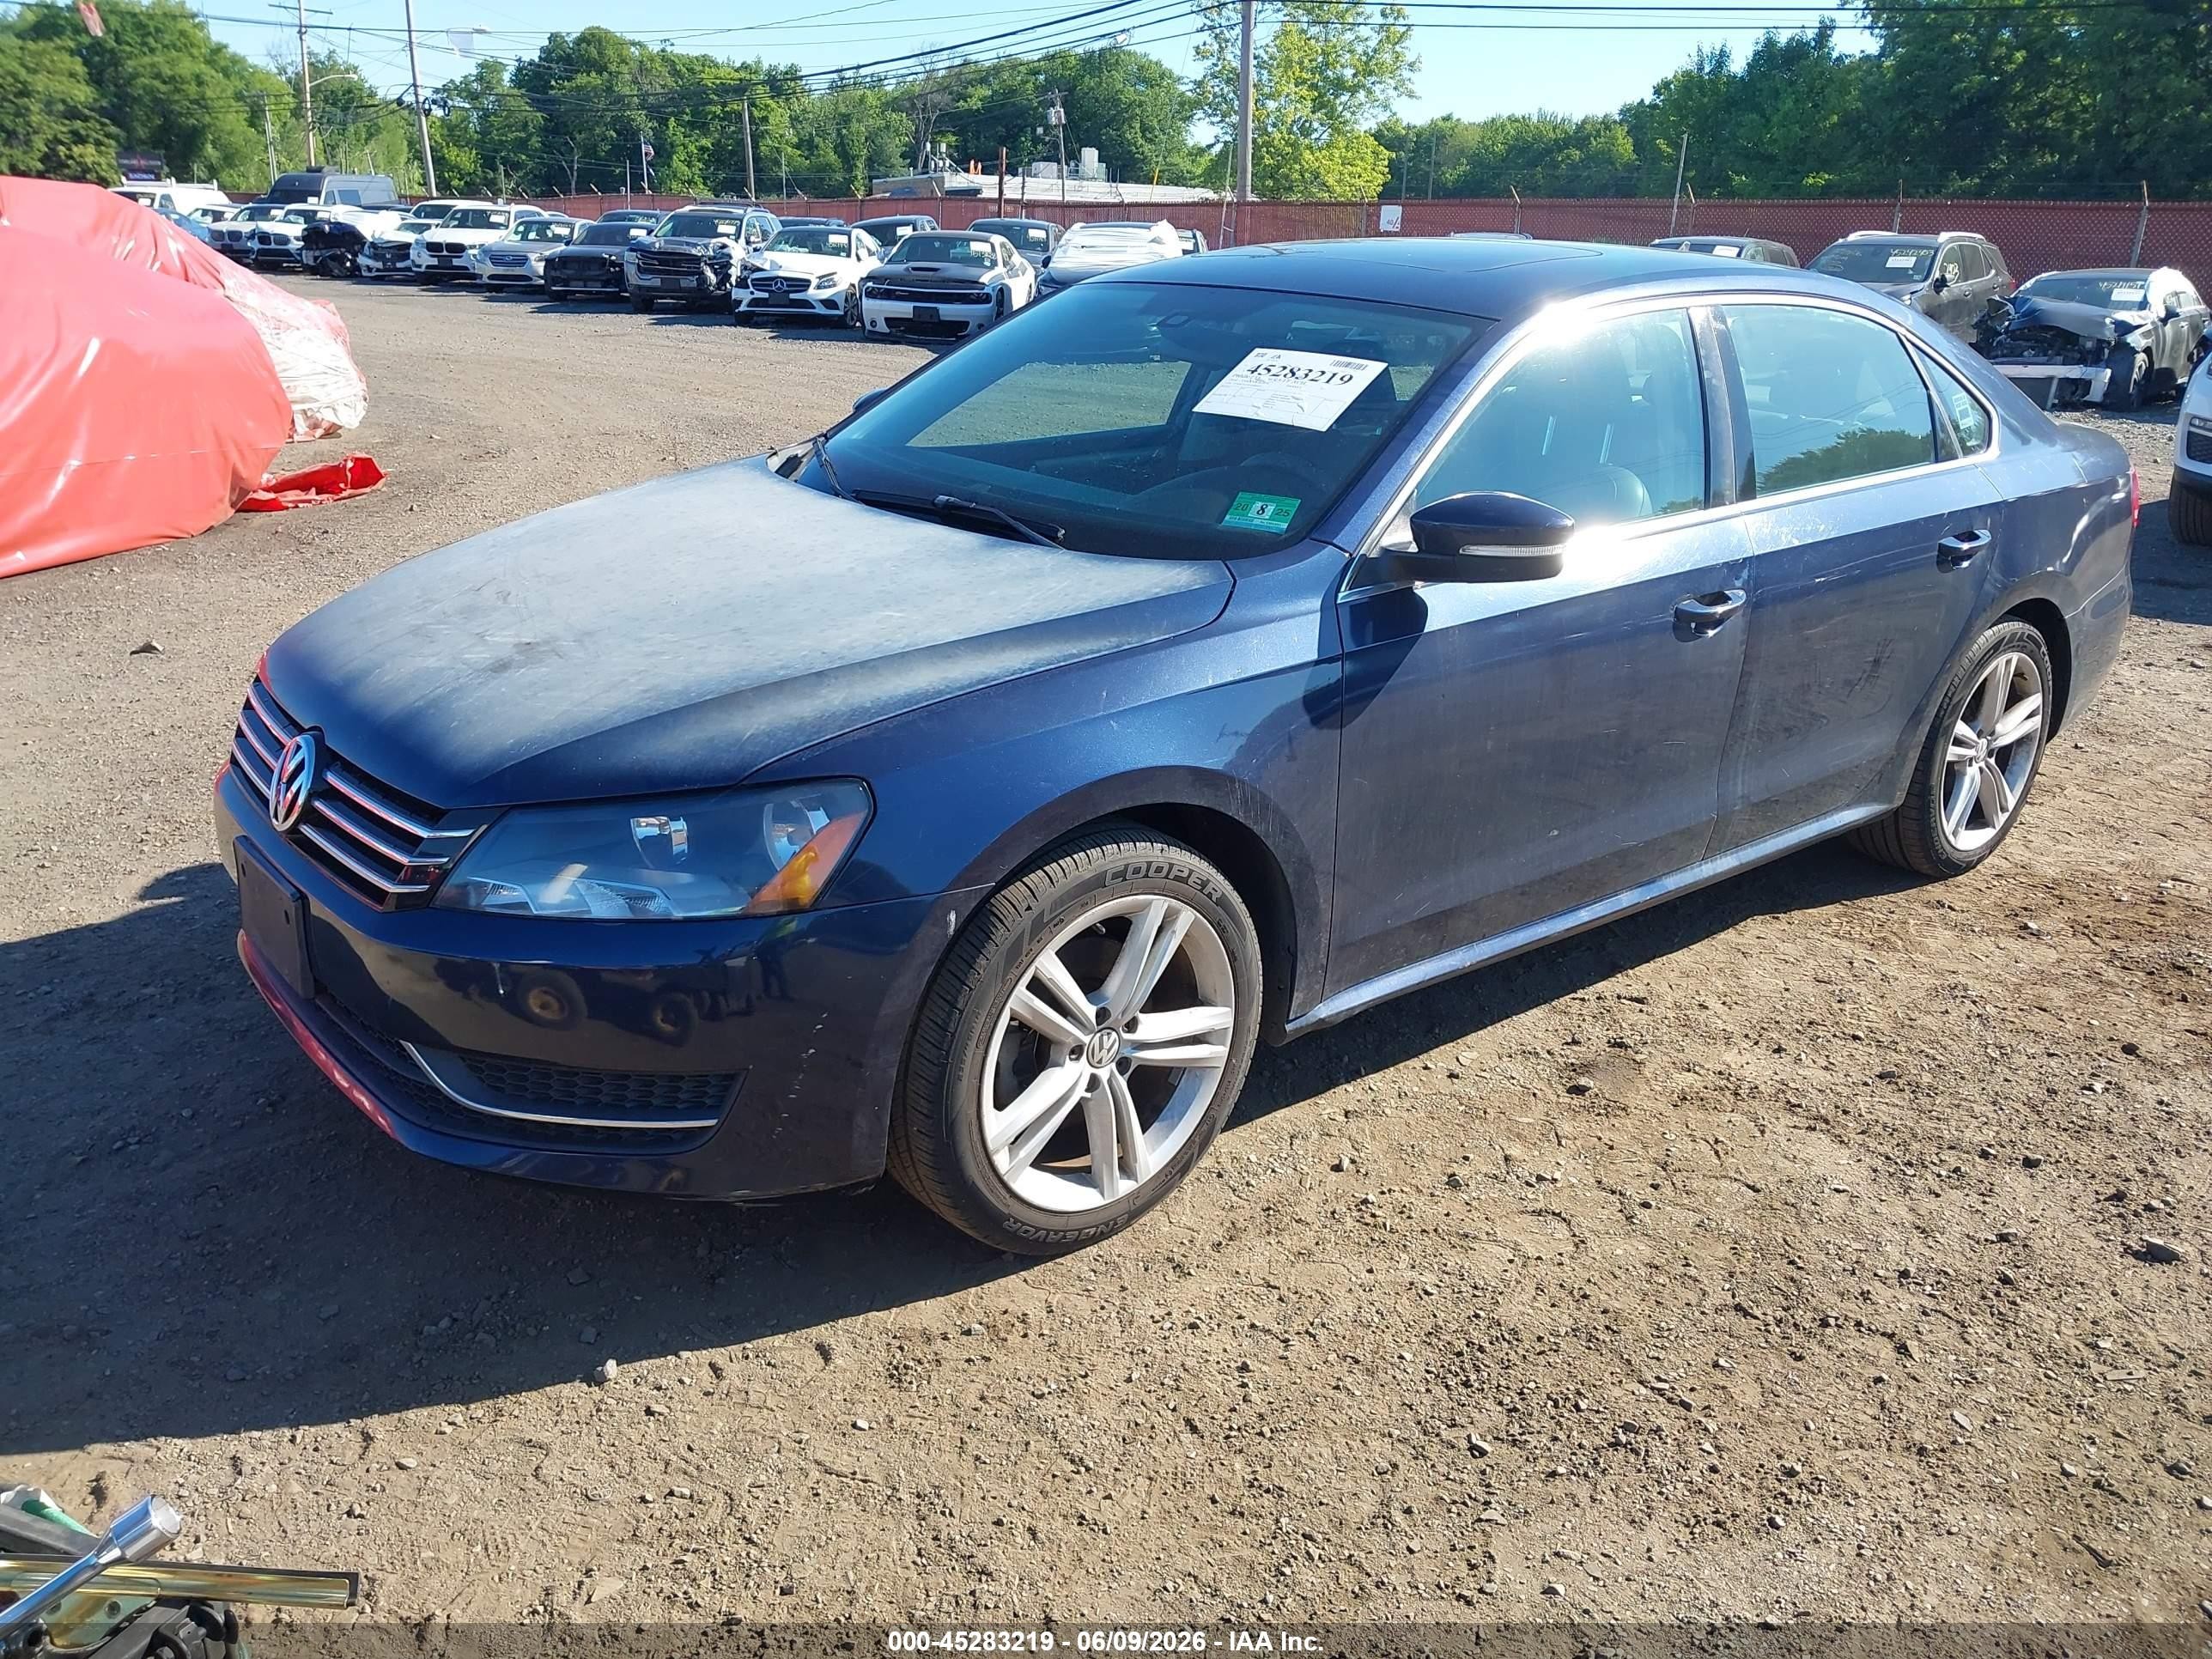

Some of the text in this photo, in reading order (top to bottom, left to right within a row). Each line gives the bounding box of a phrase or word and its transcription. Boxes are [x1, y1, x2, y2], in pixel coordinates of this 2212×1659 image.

[1246, 363, 1354, 386] 45283219
[1234, 502, 1291, 517] 20 8 25
[1105, 861, 1224, 902] COOPER
[1002, 1213, 1129, 1244] ENDEAVOR
